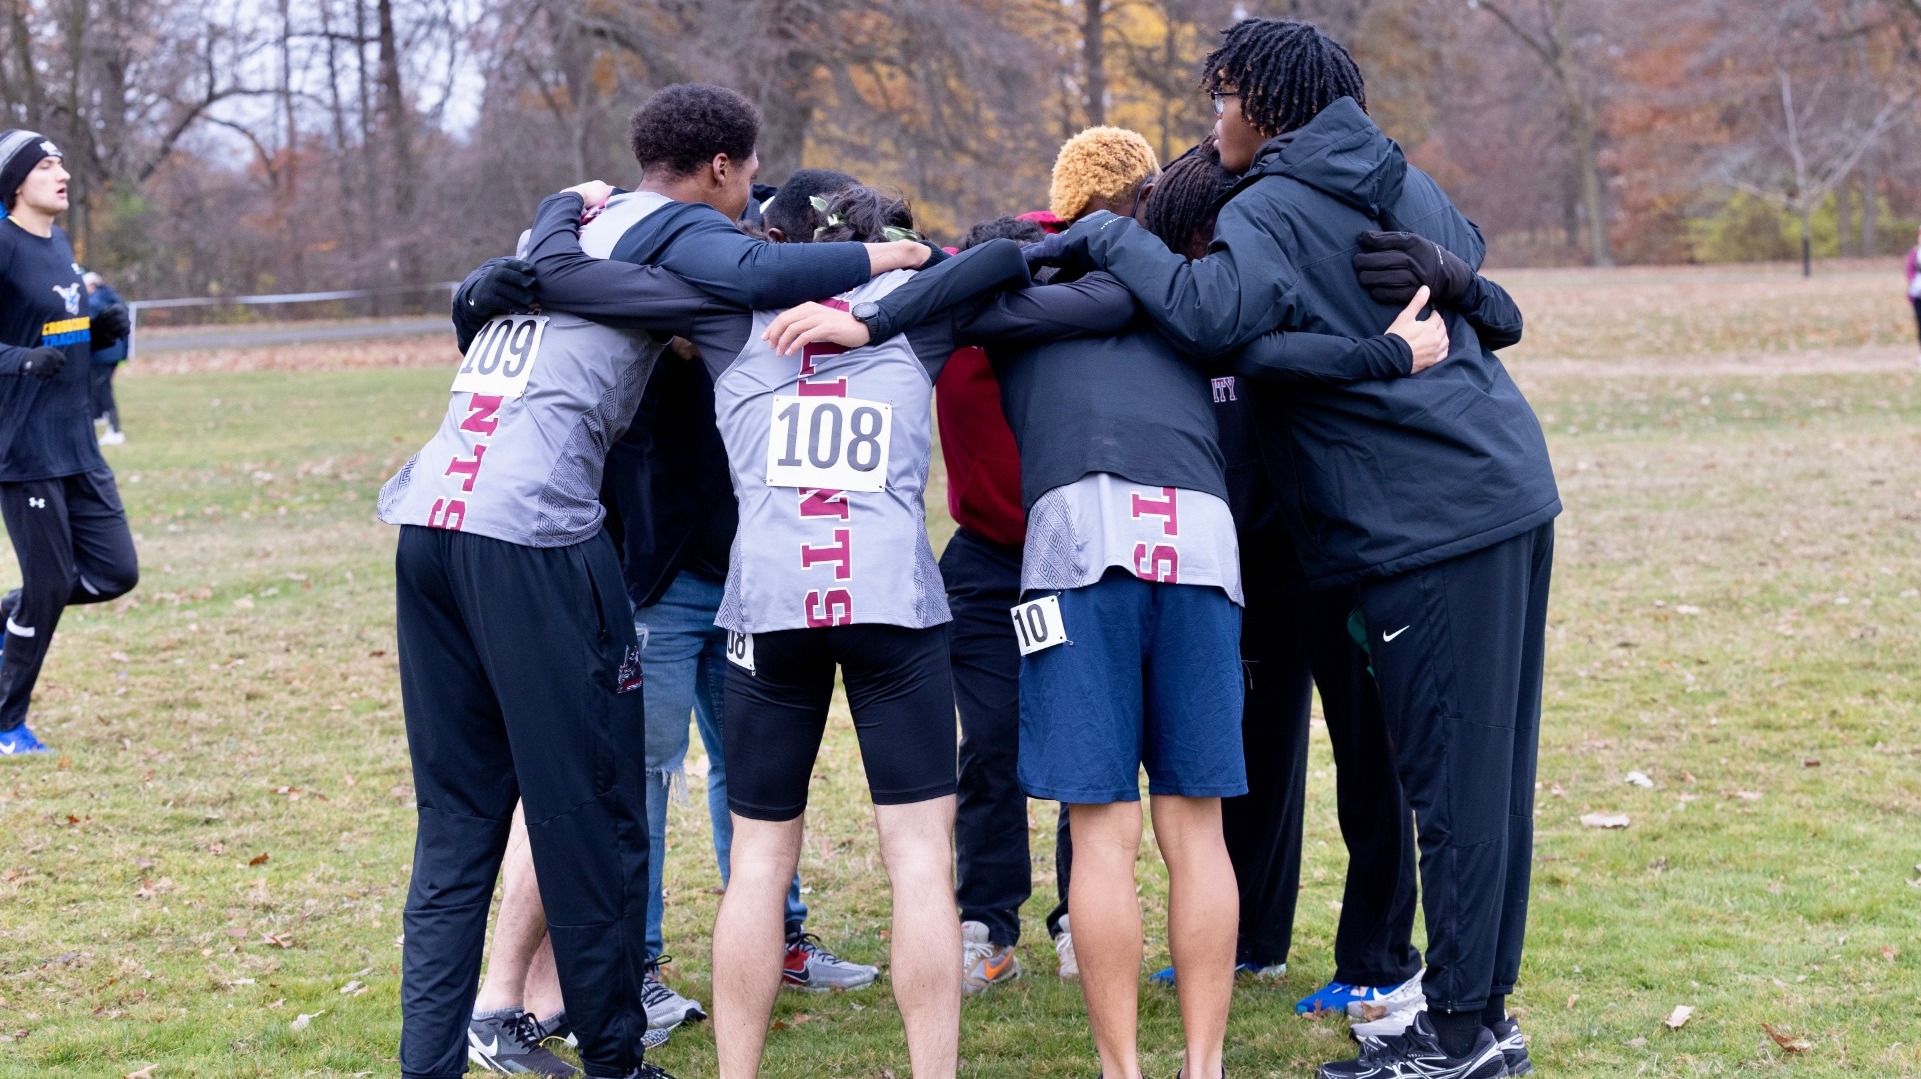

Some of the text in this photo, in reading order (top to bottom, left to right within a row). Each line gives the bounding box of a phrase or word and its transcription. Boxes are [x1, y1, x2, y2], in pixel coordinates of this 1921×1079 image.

[460, 318, 537, 378] 109
[1211, 376, 1236, 402] ITY
[777, 402, 883, 473] 108
[1014, 603, 1049, 648] 10
